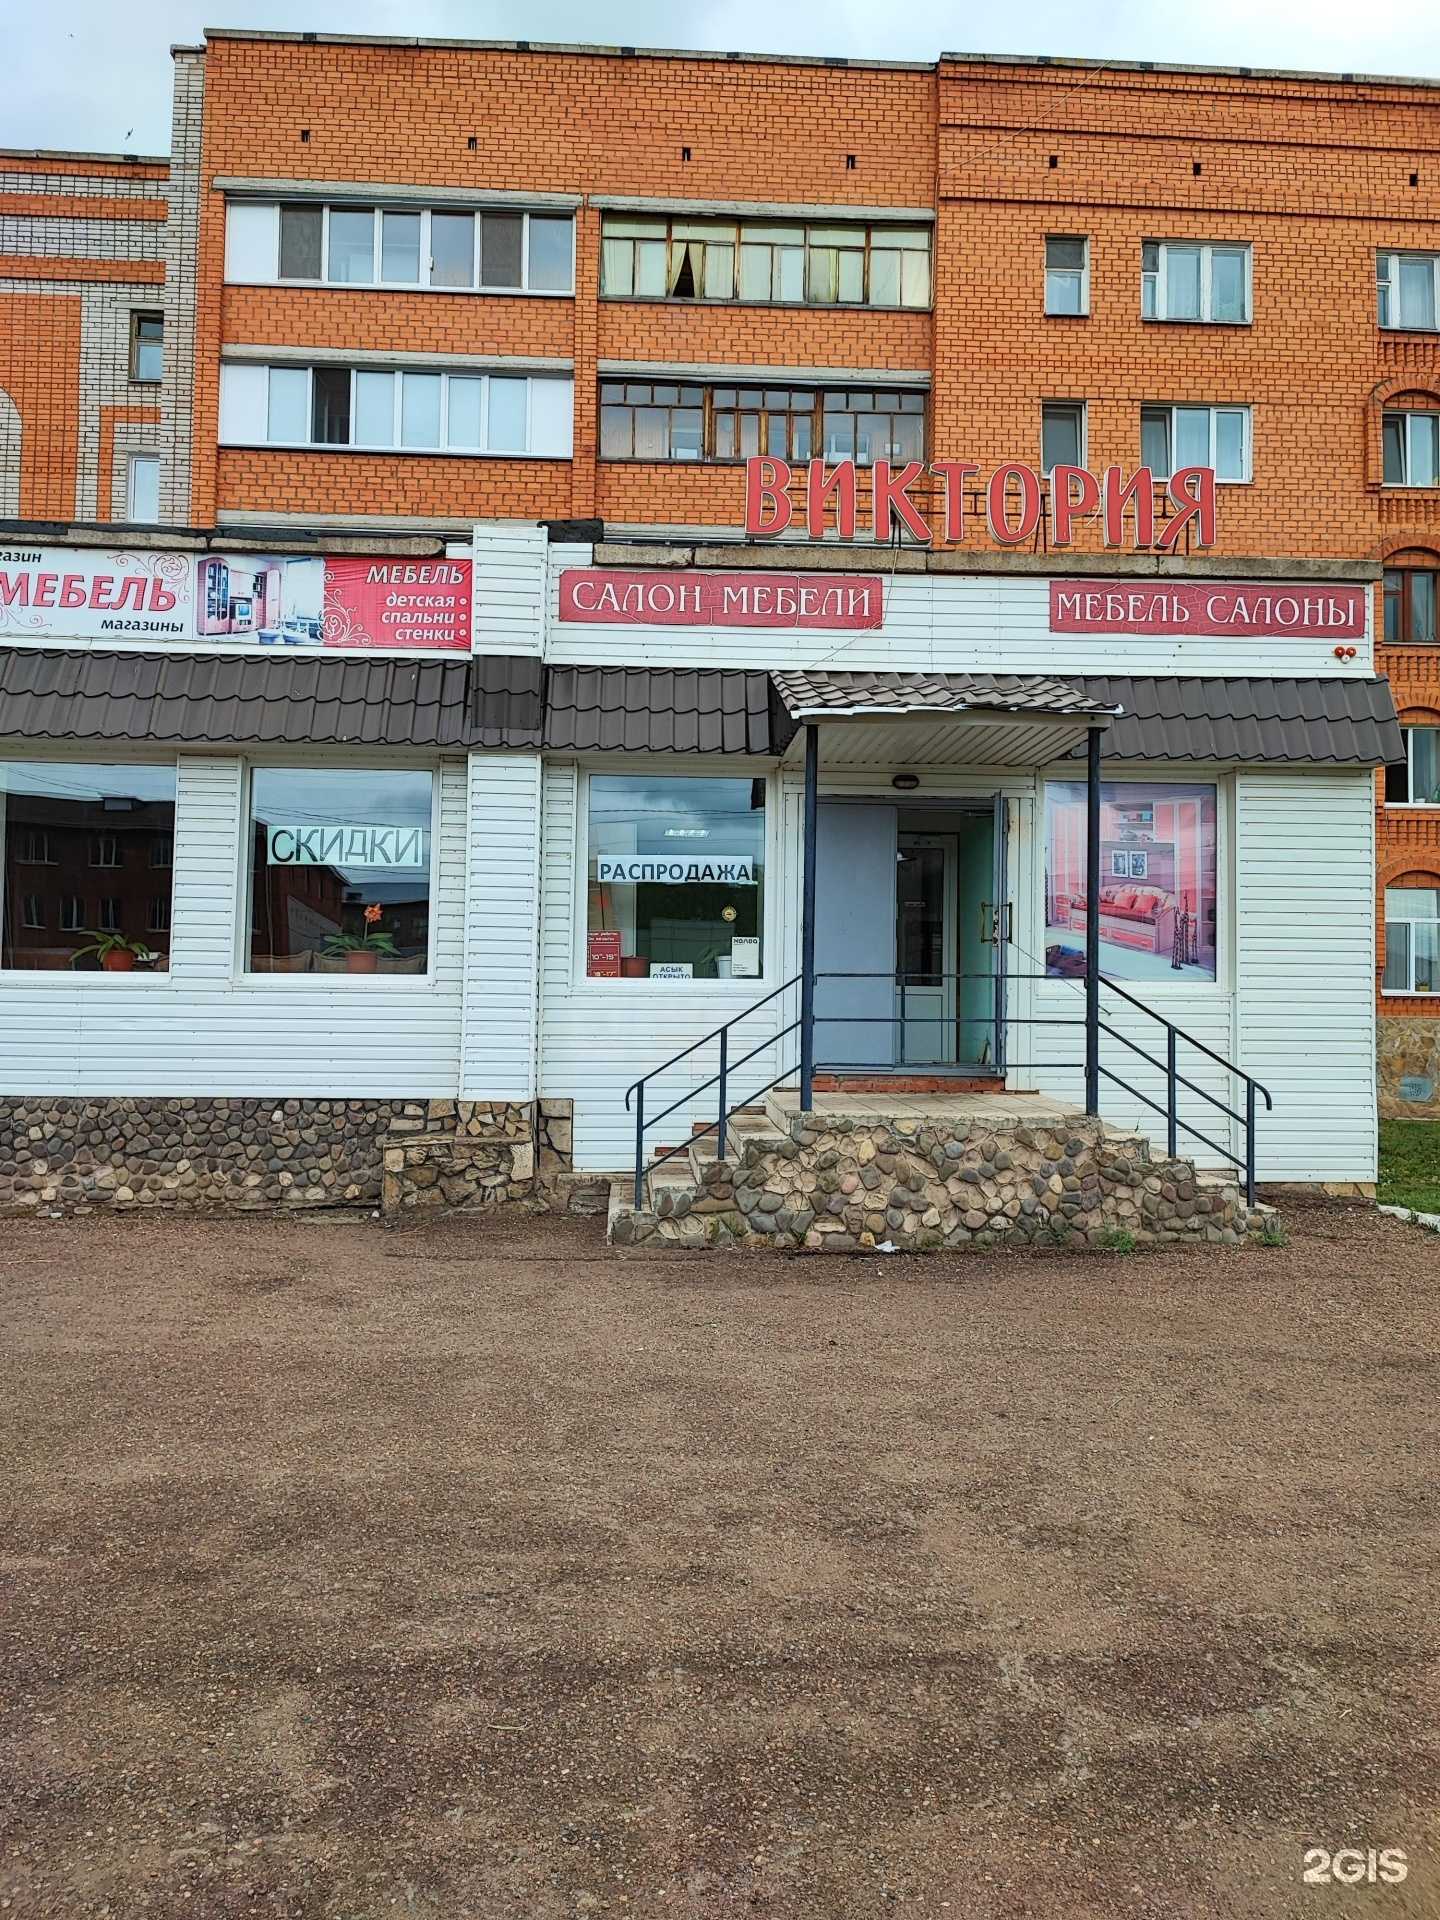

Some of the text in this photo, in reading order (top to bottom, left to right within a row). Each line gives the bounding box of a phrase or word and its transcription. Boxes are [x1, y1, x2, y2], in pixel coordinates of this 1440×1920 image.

[745, 455, 1217, 549] ВИКТОРИЯ
[366, 564, 464, 585] МЕБЕЛЬ
[0, 571, 177, 612] МЕБЕЛЬ
[385, 591, 455, 607] детская
[572, 582, 870, 617] САЛОН МЕБЕЛИ
[381, 612, 455, 624] спальни
[1056, 593, 1355, 626] МЕБЕЛЬ САЛОНЫ
[100, 618, 184, 633] магазины
[395, 628, 455, 641] стенки
[271, 829, 420, 864] СКИДКИ
[600, 863, 751, 882] РАСПРОДАЖА
